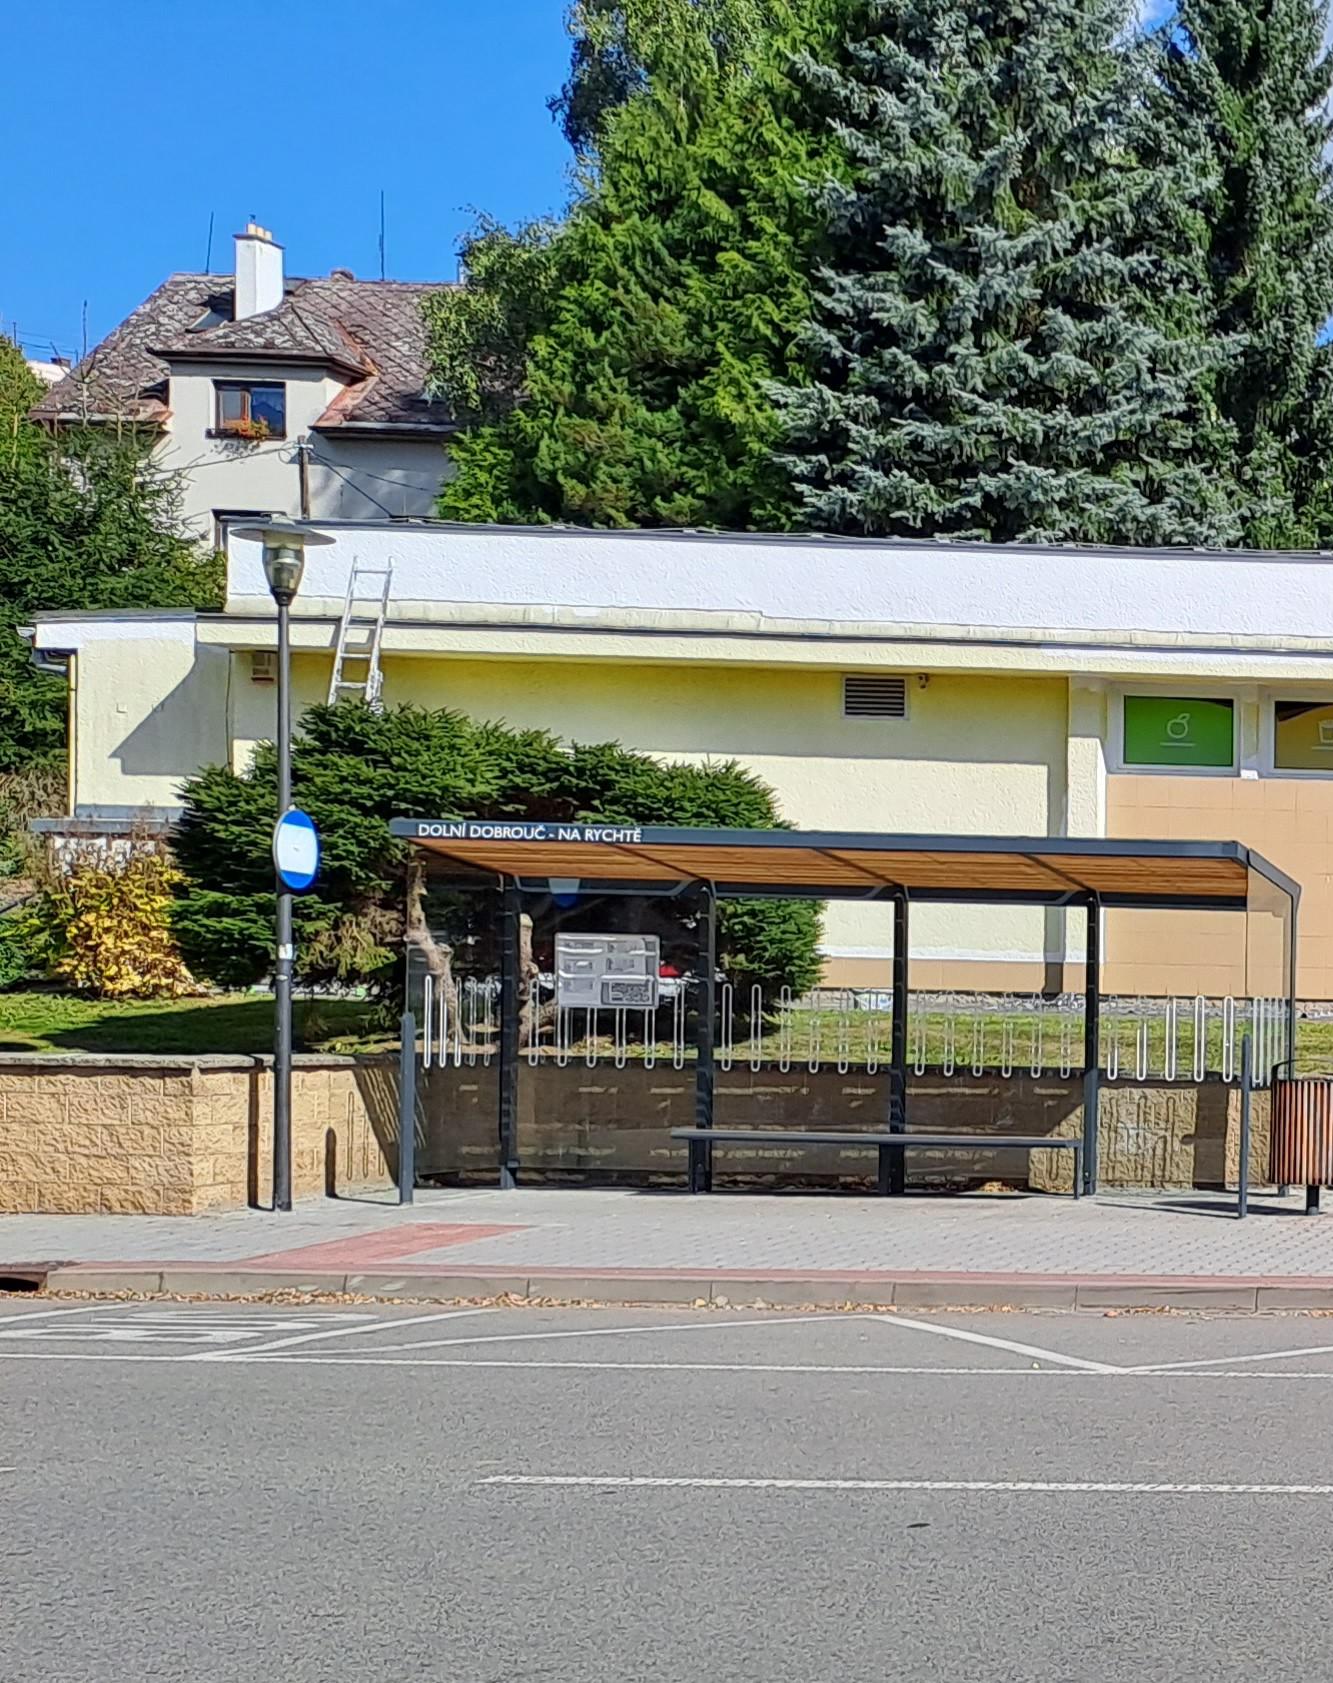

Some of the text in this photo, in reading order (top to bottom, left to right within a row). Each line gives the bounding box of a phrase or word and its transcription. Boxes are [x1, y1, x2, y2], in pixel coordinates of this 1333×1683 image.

[418, 822, 466, 838] DOLNÍ
[470, 823, 546, 840] DOBROUČ
[558, 827, 581, 841] NA
[584, 826, 642, 843] RYCHTĚ
